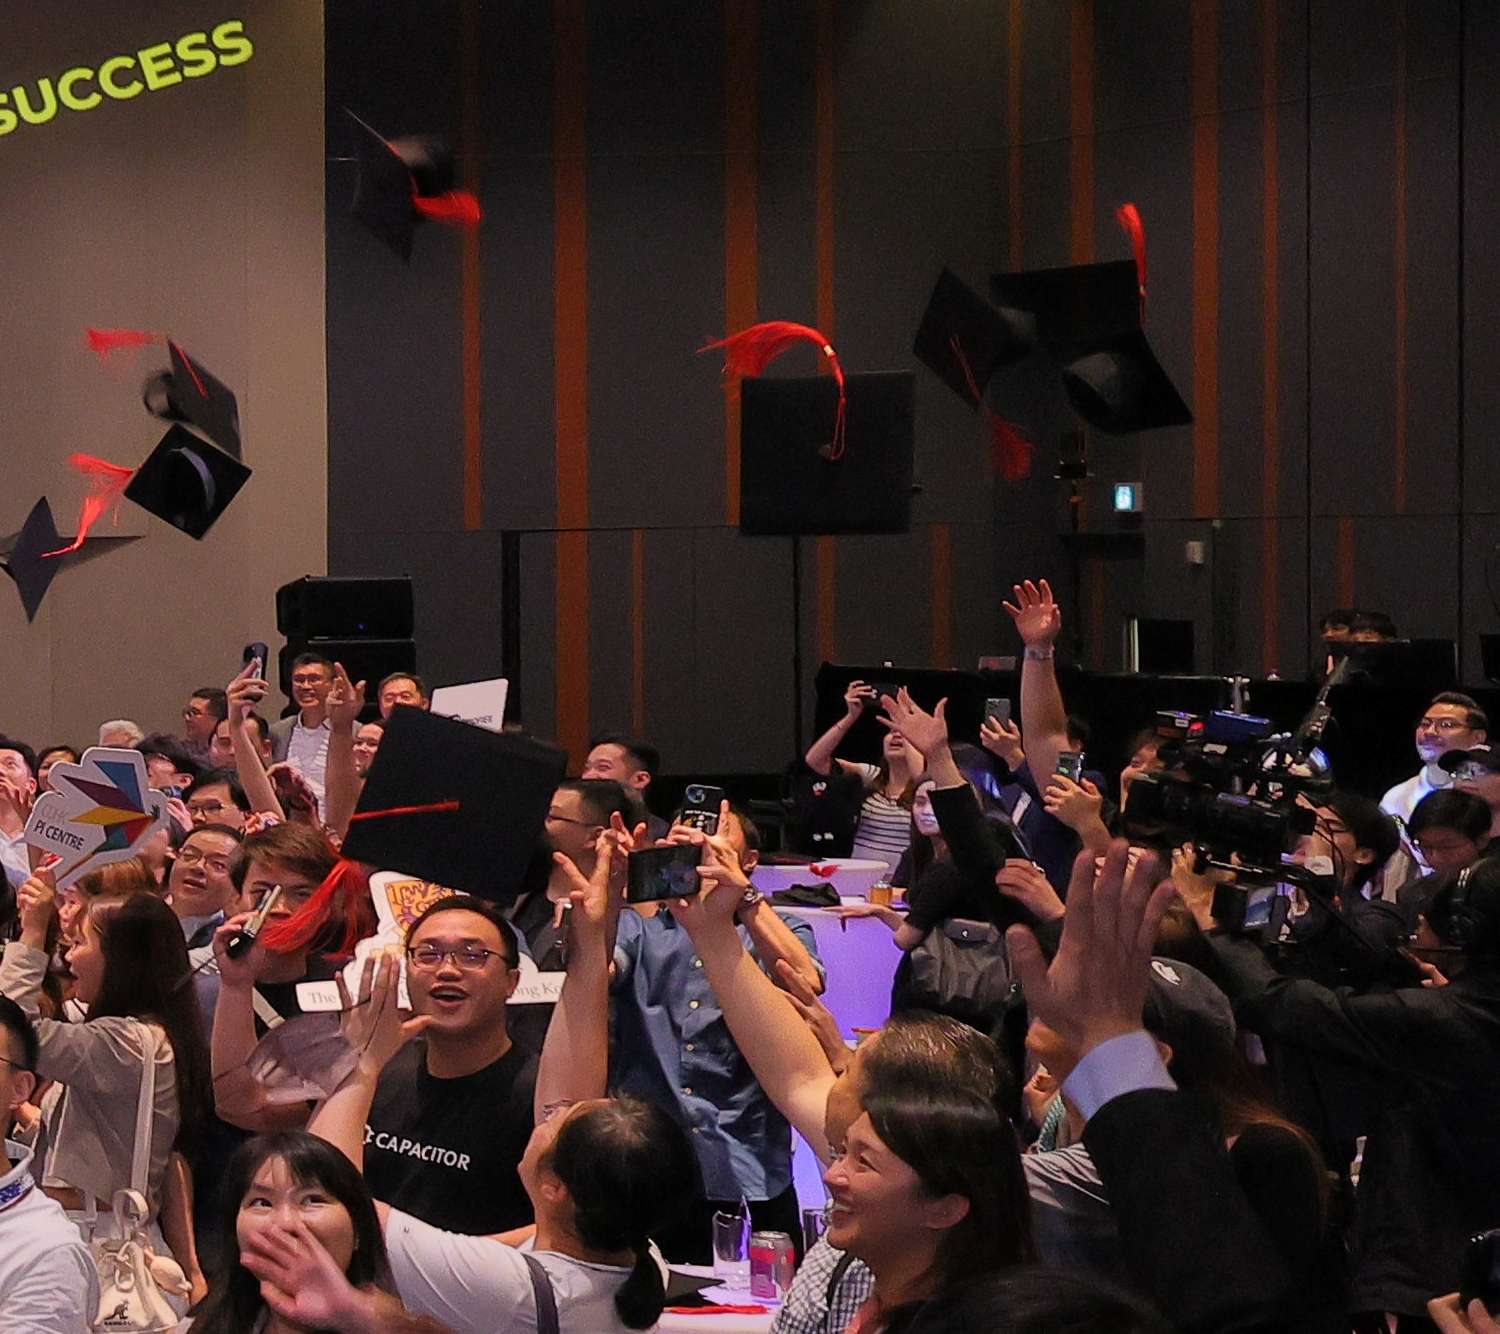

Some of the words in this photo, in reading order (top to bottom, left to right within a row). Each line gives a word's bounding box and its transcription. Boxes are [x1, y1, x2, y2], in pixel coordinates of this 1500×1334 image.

[33, 819, 45, 836] PI
[45, 825, 85, 851] CENTRE
[307, 991, 337, 1005] The
[375, 1132, 472, 1171] CAPACITOR
